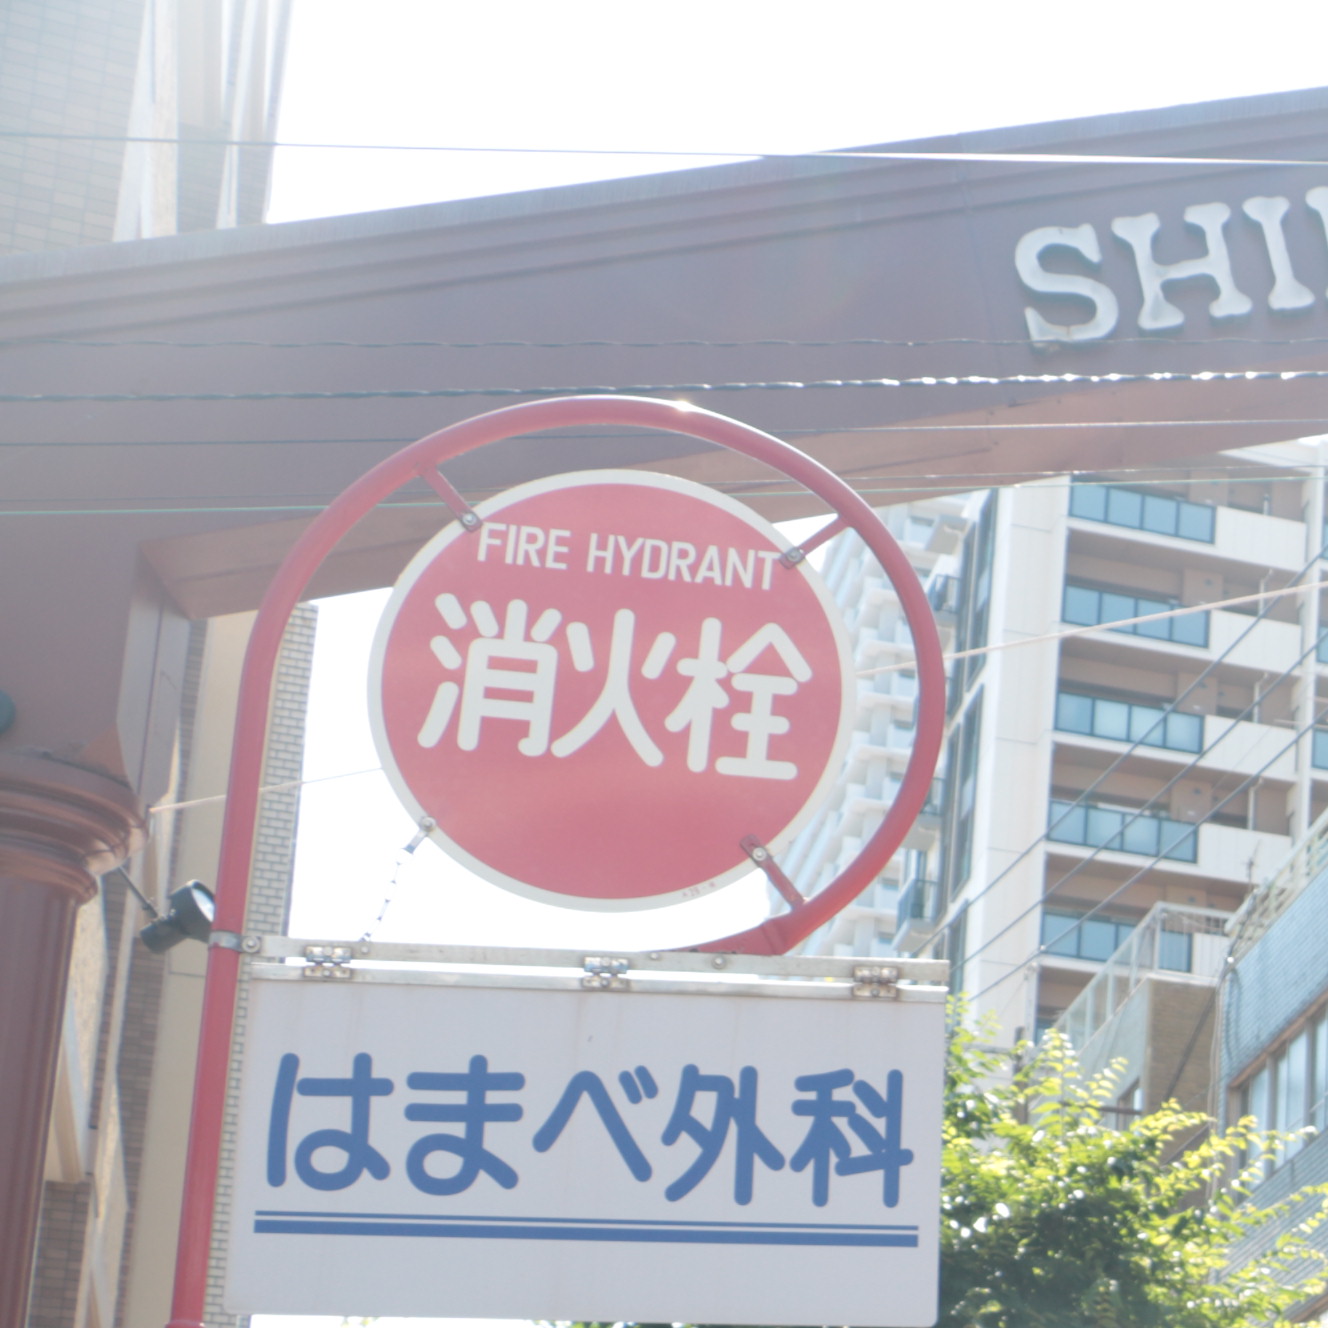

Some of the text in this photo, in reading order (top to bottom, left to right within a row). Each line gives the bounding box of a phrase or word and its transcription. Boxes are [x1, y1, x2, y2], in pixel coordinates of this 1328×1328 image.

[476, 523, 784, 592] FIRE HYDRANT
[416, 592, 813, 782] 消火栓
[265, 1051, 915, 1209] はまべ外科
